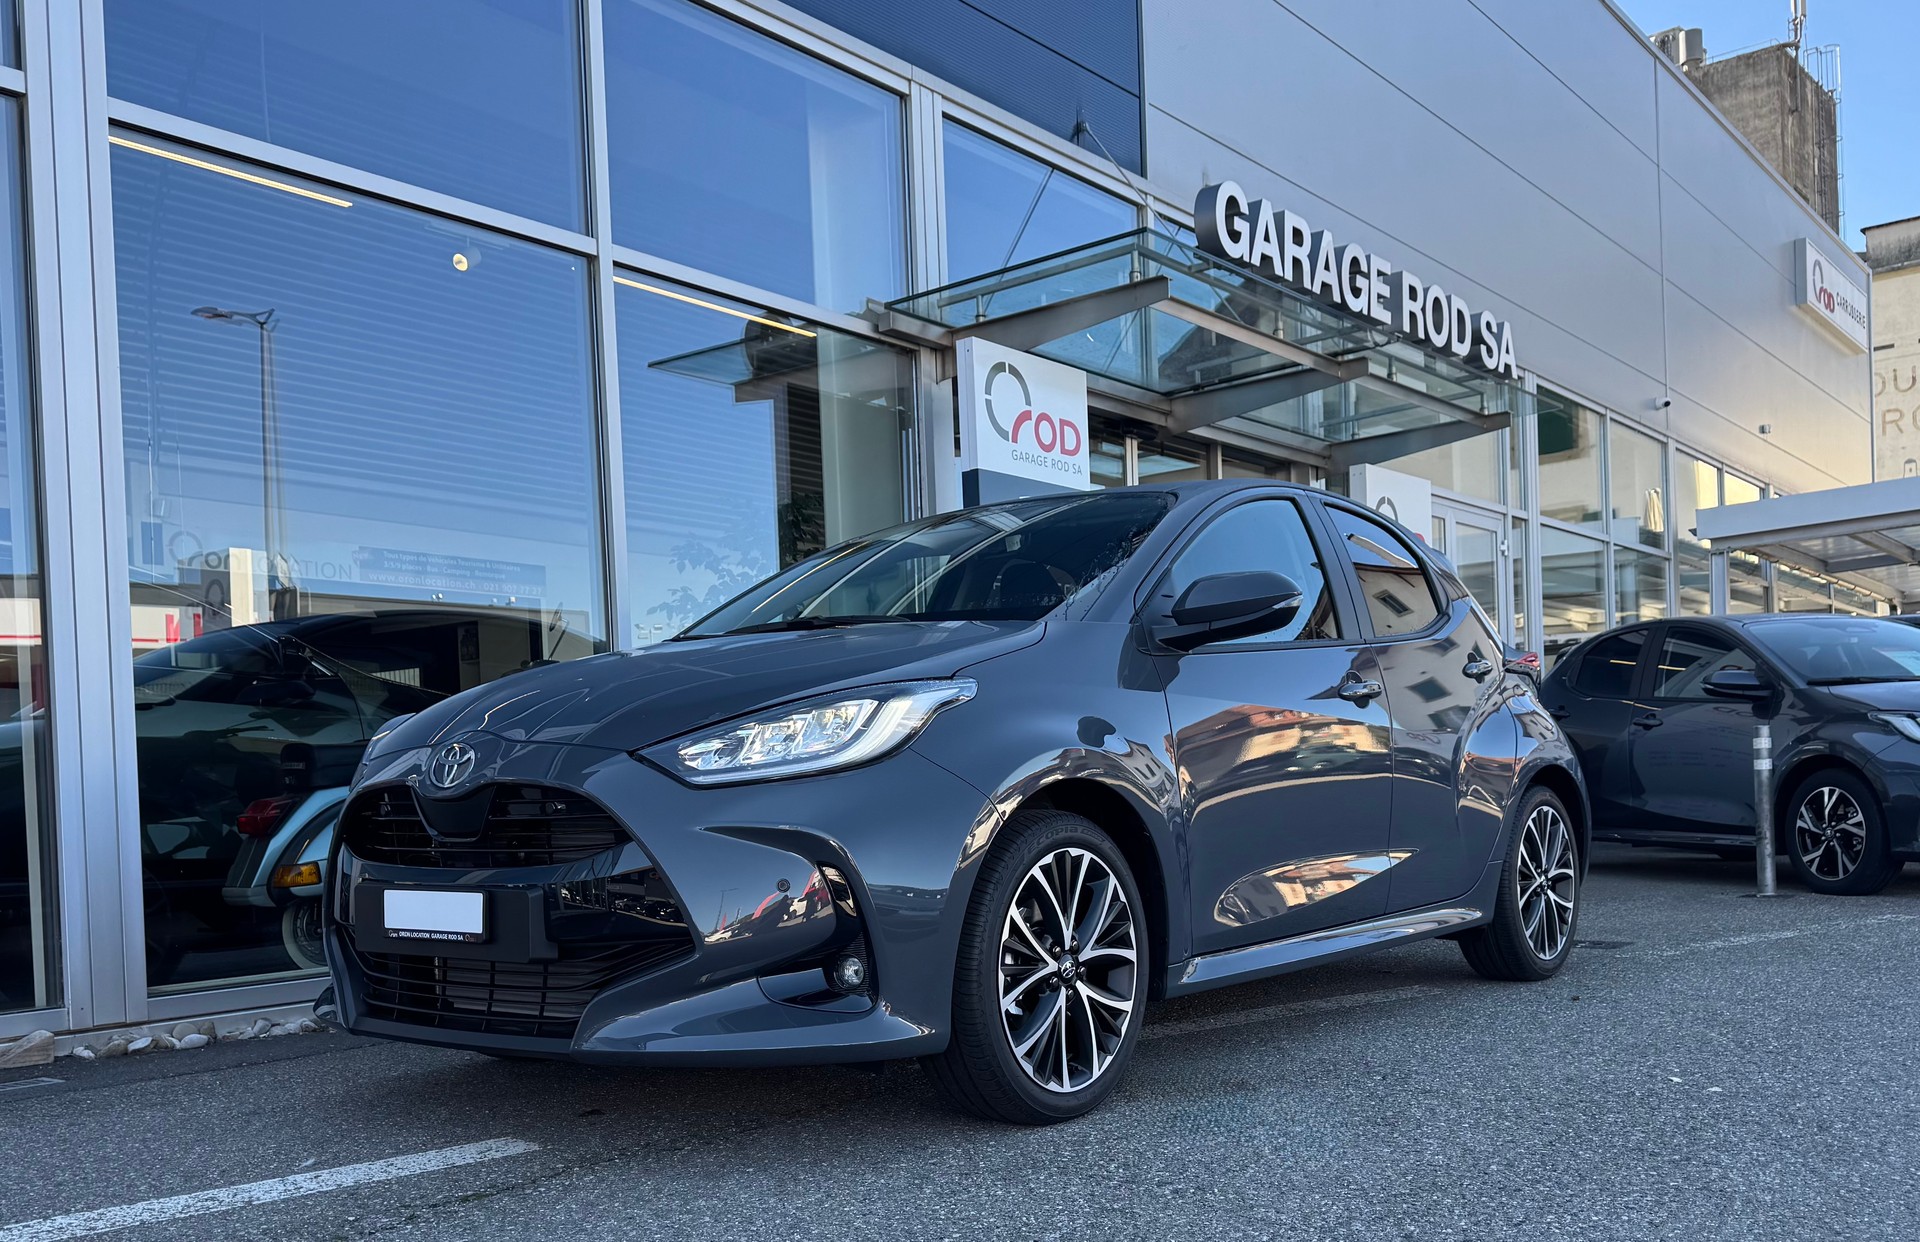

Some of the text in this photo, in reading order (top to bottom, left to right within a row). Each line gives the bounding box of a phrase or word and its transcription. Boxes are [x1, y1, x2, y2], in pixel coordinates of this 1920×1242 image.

[1212, 180, 1518, 380] GARAGE ROD SA
[1011, 448, 1083, 476] GARAGE ROD SA
